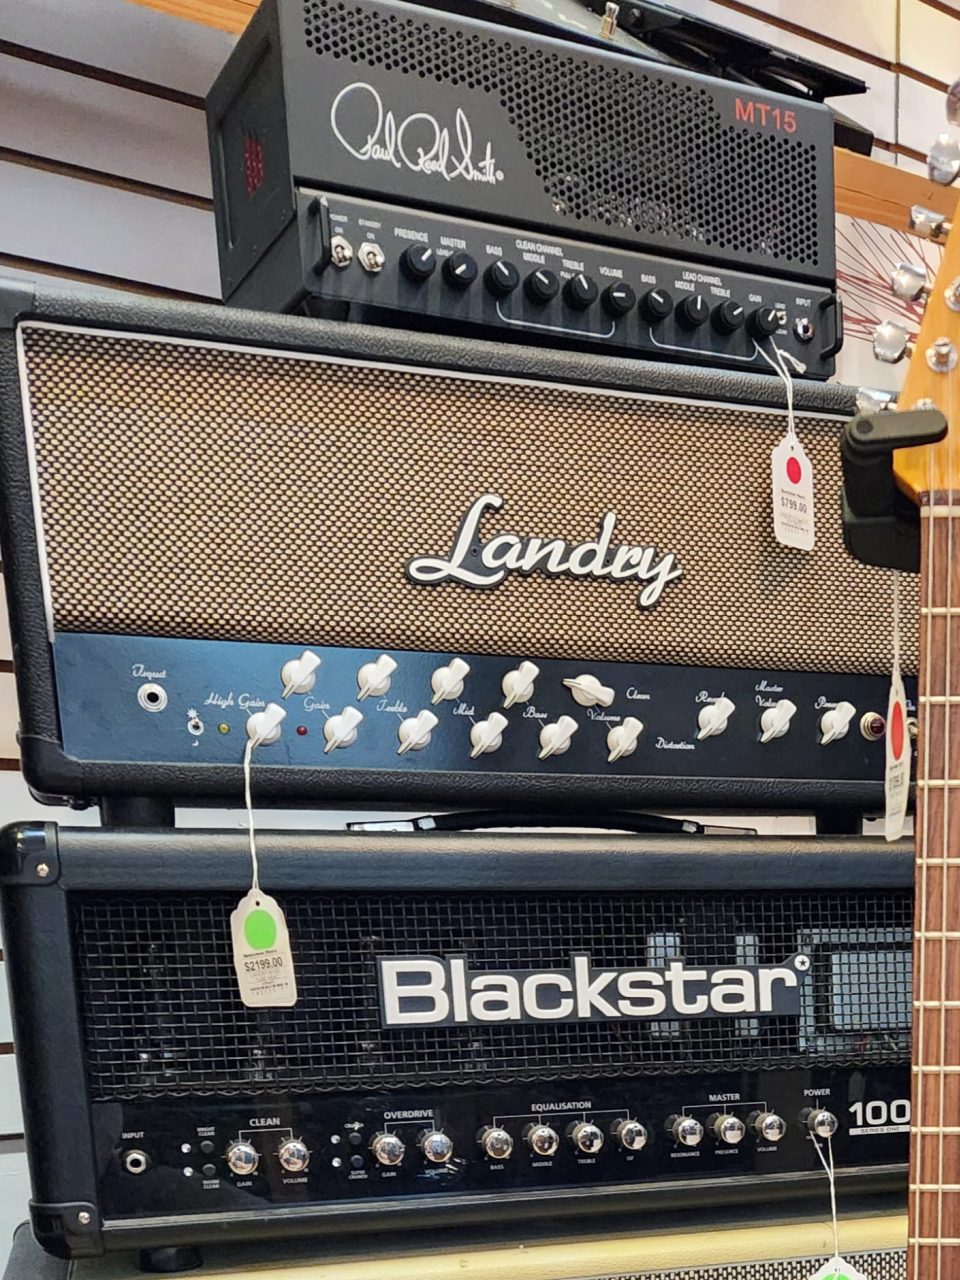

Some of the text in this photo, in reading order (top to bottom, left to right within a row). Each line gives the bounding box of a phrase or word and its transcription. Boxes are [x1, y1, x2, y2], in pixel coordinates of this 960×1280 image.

[735, 97, 797, 133] MT15
[331, 82, 498, 186] Paul Reed Smith
[394, 227, 428, 243] PRESENCE
[440, 236, 467, 249] MASTER
[515, 239, 536, 251] CLEAN
[485, 244, 503, 257] BASS
[562, 259, 584, 271] TREBLE
[599, 266, 623, 278] VOLUME
[682, 271, 697, 282] LEAD
[641, 274, 656, 284] BASS
[710, 286, 731, 298] TREBLE
[781, 496, 807, 514] $799.00
[409, 493, 683, 606] Landry
[626, 687, 650, 700] Clean
[204, 692, 265, 710] High Gain
[304, 696, 330, 712] Gain
[755, 694, 776, 707] Volu
[453, 703, 475, 716] Mid
[523, 706, 547, 719] Bass
[587, 708, 620, 722] Volume
[655, 736, 696, 750] Distortion
[244, 956, 283, 972] $2199.00
[380, 956, 798, 1025] Blackstar
[709, 1093, 740, 1102] MASTER
[803, 1088, 831, 1097] POWER
[531, 1101, 592, 1111] EQUALISATION
[848, 1099, 911, 1126] 100
[383, 1109, 434, 1120] OVERDRIVE
[249, 1117, 280, 1127] CLEAN
[122, 1131, 145, 1140] INPUT
[282, 1176, 308, 1184] VOLUME
